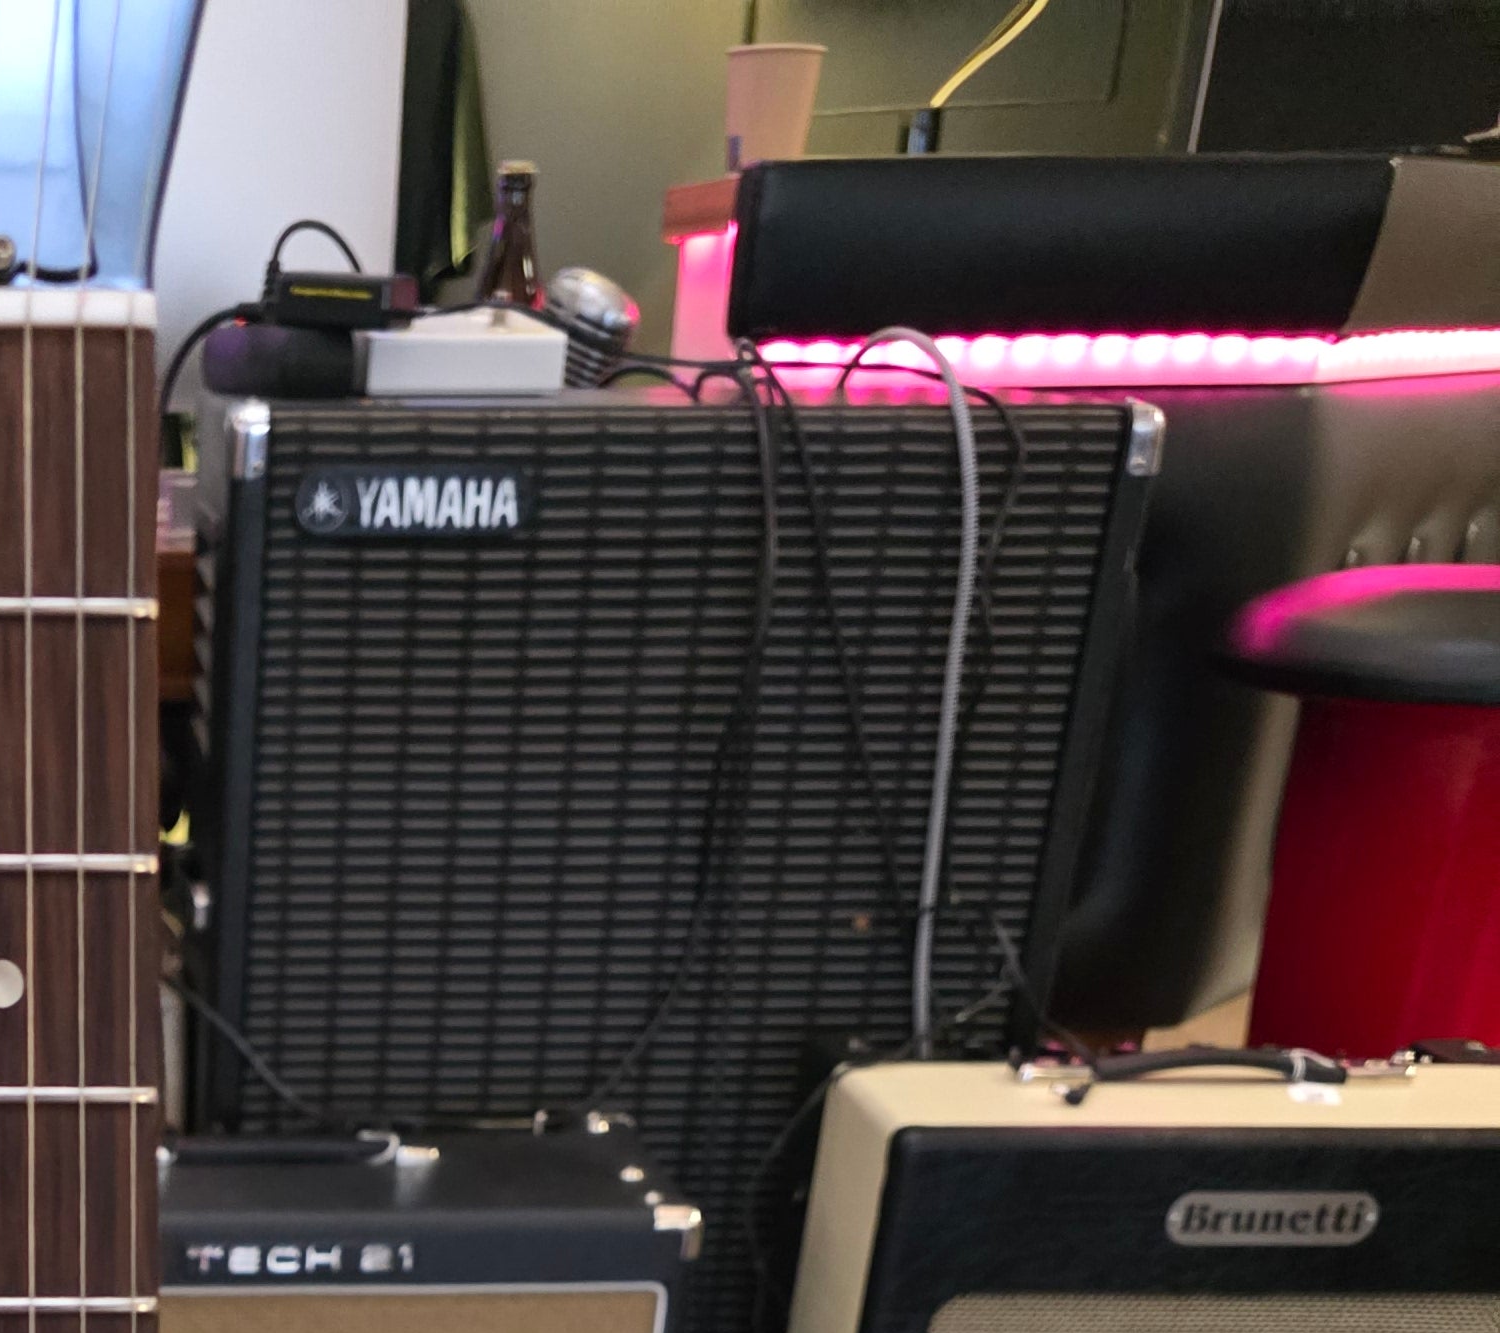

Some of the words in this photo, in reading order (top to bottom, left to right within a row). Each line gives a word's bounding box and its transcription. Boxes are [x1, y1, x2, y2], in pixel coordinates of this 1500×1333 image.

[357, 477, 519, 527] YAMAHA
[1180, 1201, 1366, 1237] Brunetti
[186, 1245, 342, 1274] TECH
[359, 1243, 415, 1272] 21
